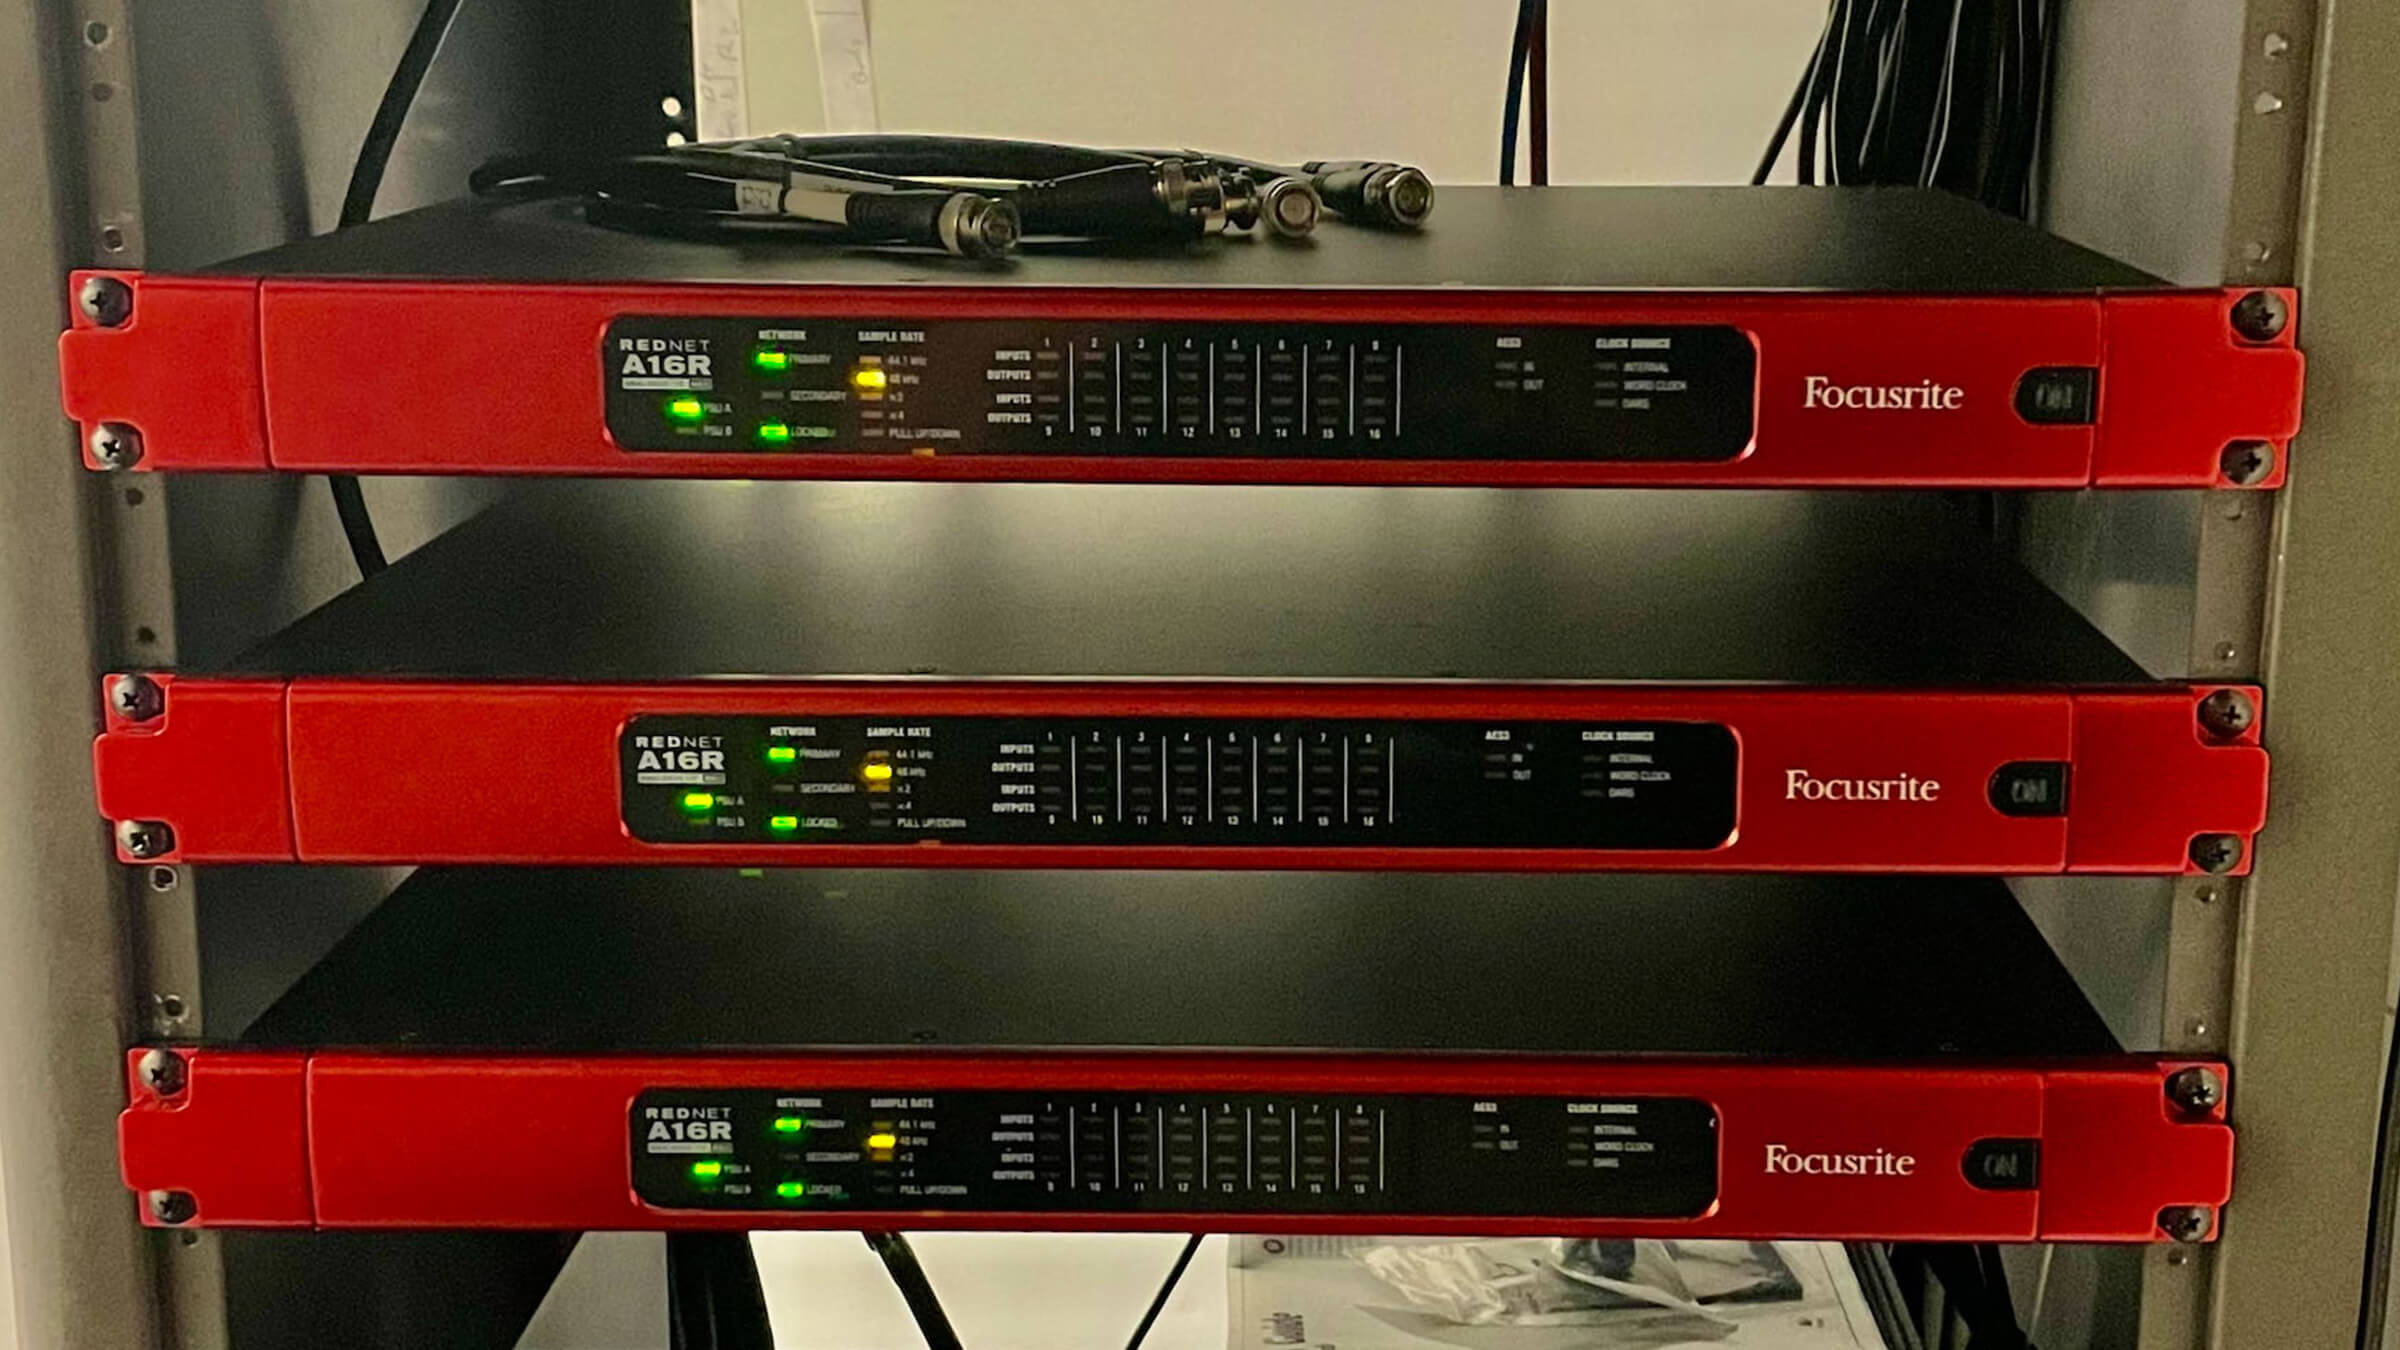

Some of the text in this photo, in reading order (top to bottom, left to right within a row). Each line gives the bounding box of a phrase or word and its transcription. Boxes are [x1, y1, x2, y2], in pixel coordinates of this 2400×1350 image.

[620, 339, 711, 351] REDNET
[622, 354, 712, 375] A16R
[1803, 375, 1964, 409] Focusrite
[635, 736, 724, 749] REDNET
[637, 750, 725, 770] A16R
[1785, 769, 1941, 802] Focusrite
[2011, 779, 2048, 803] ON
[645, 1107, 732, 1120] REDNET
[647, 1121, 732, 1140] A16R
[1764, 1143, 1916, 1176] Focusrite
[1983, 1153, 2018, 1177] ON
